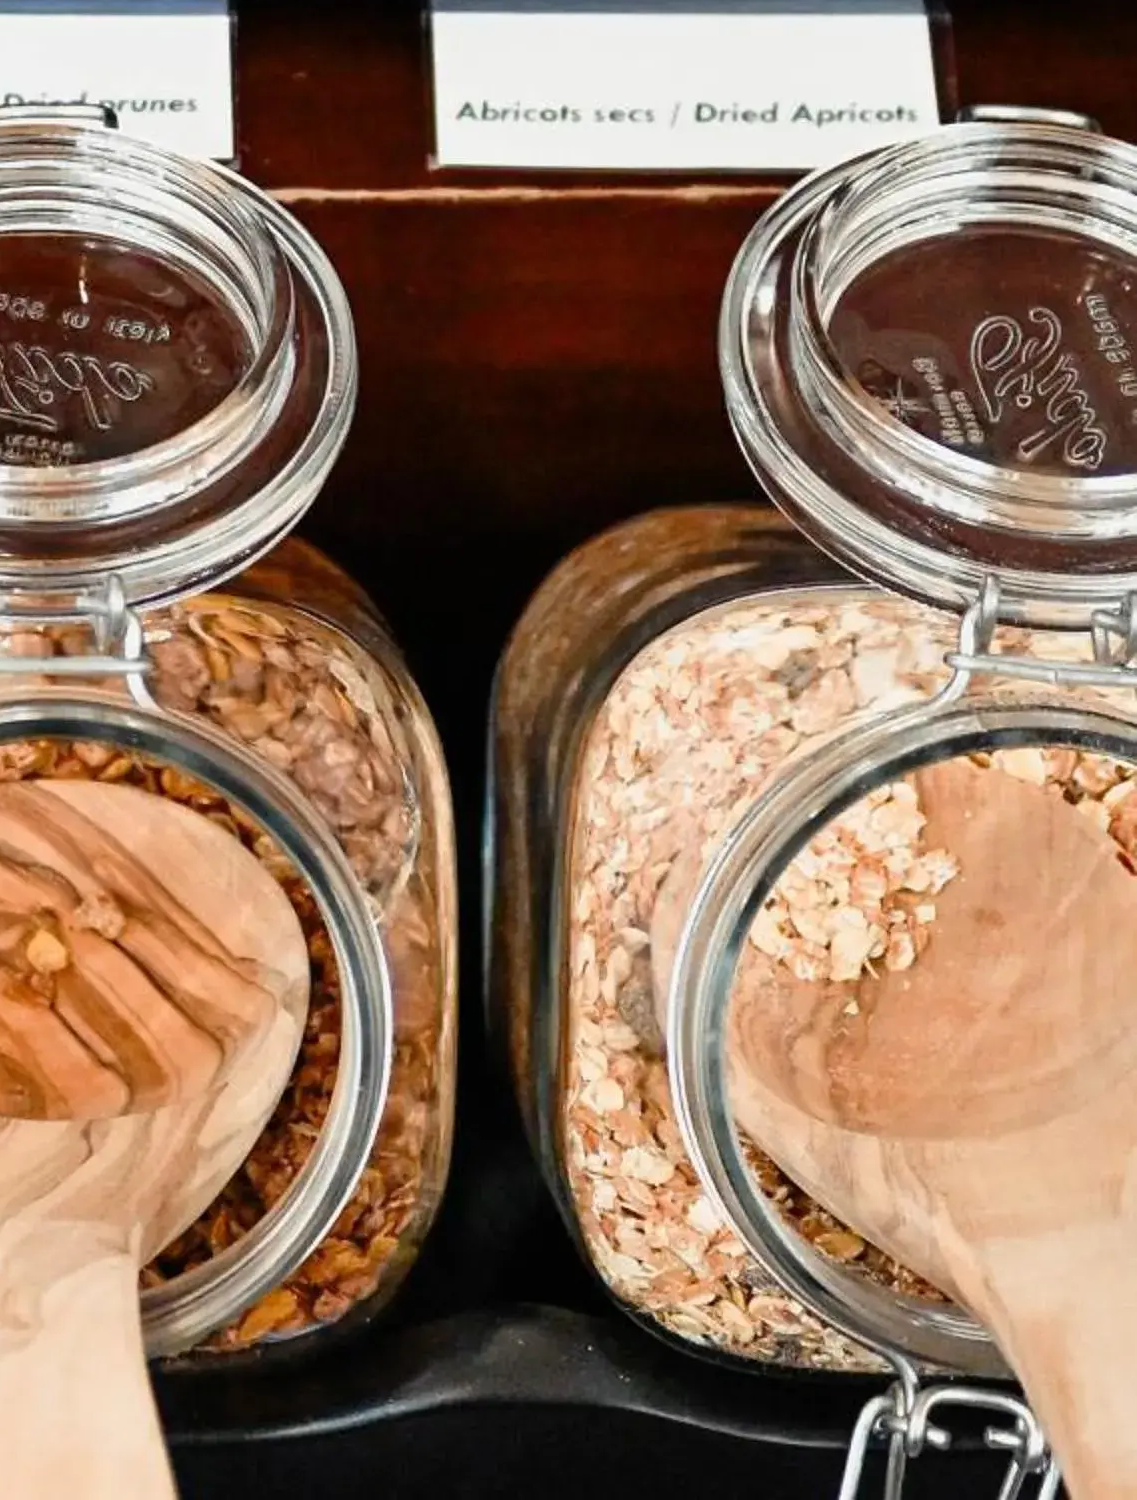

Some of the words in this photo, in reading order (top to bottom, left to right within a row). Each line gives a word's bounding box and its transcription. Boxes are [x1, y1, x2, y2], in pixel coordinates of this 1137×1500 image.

[455, 101, 582, 122] Abricots
[594, 108, 655, 123] secs
[695, 101, 778, 123] Dried
[791, 101, 918, 129] Apricots
